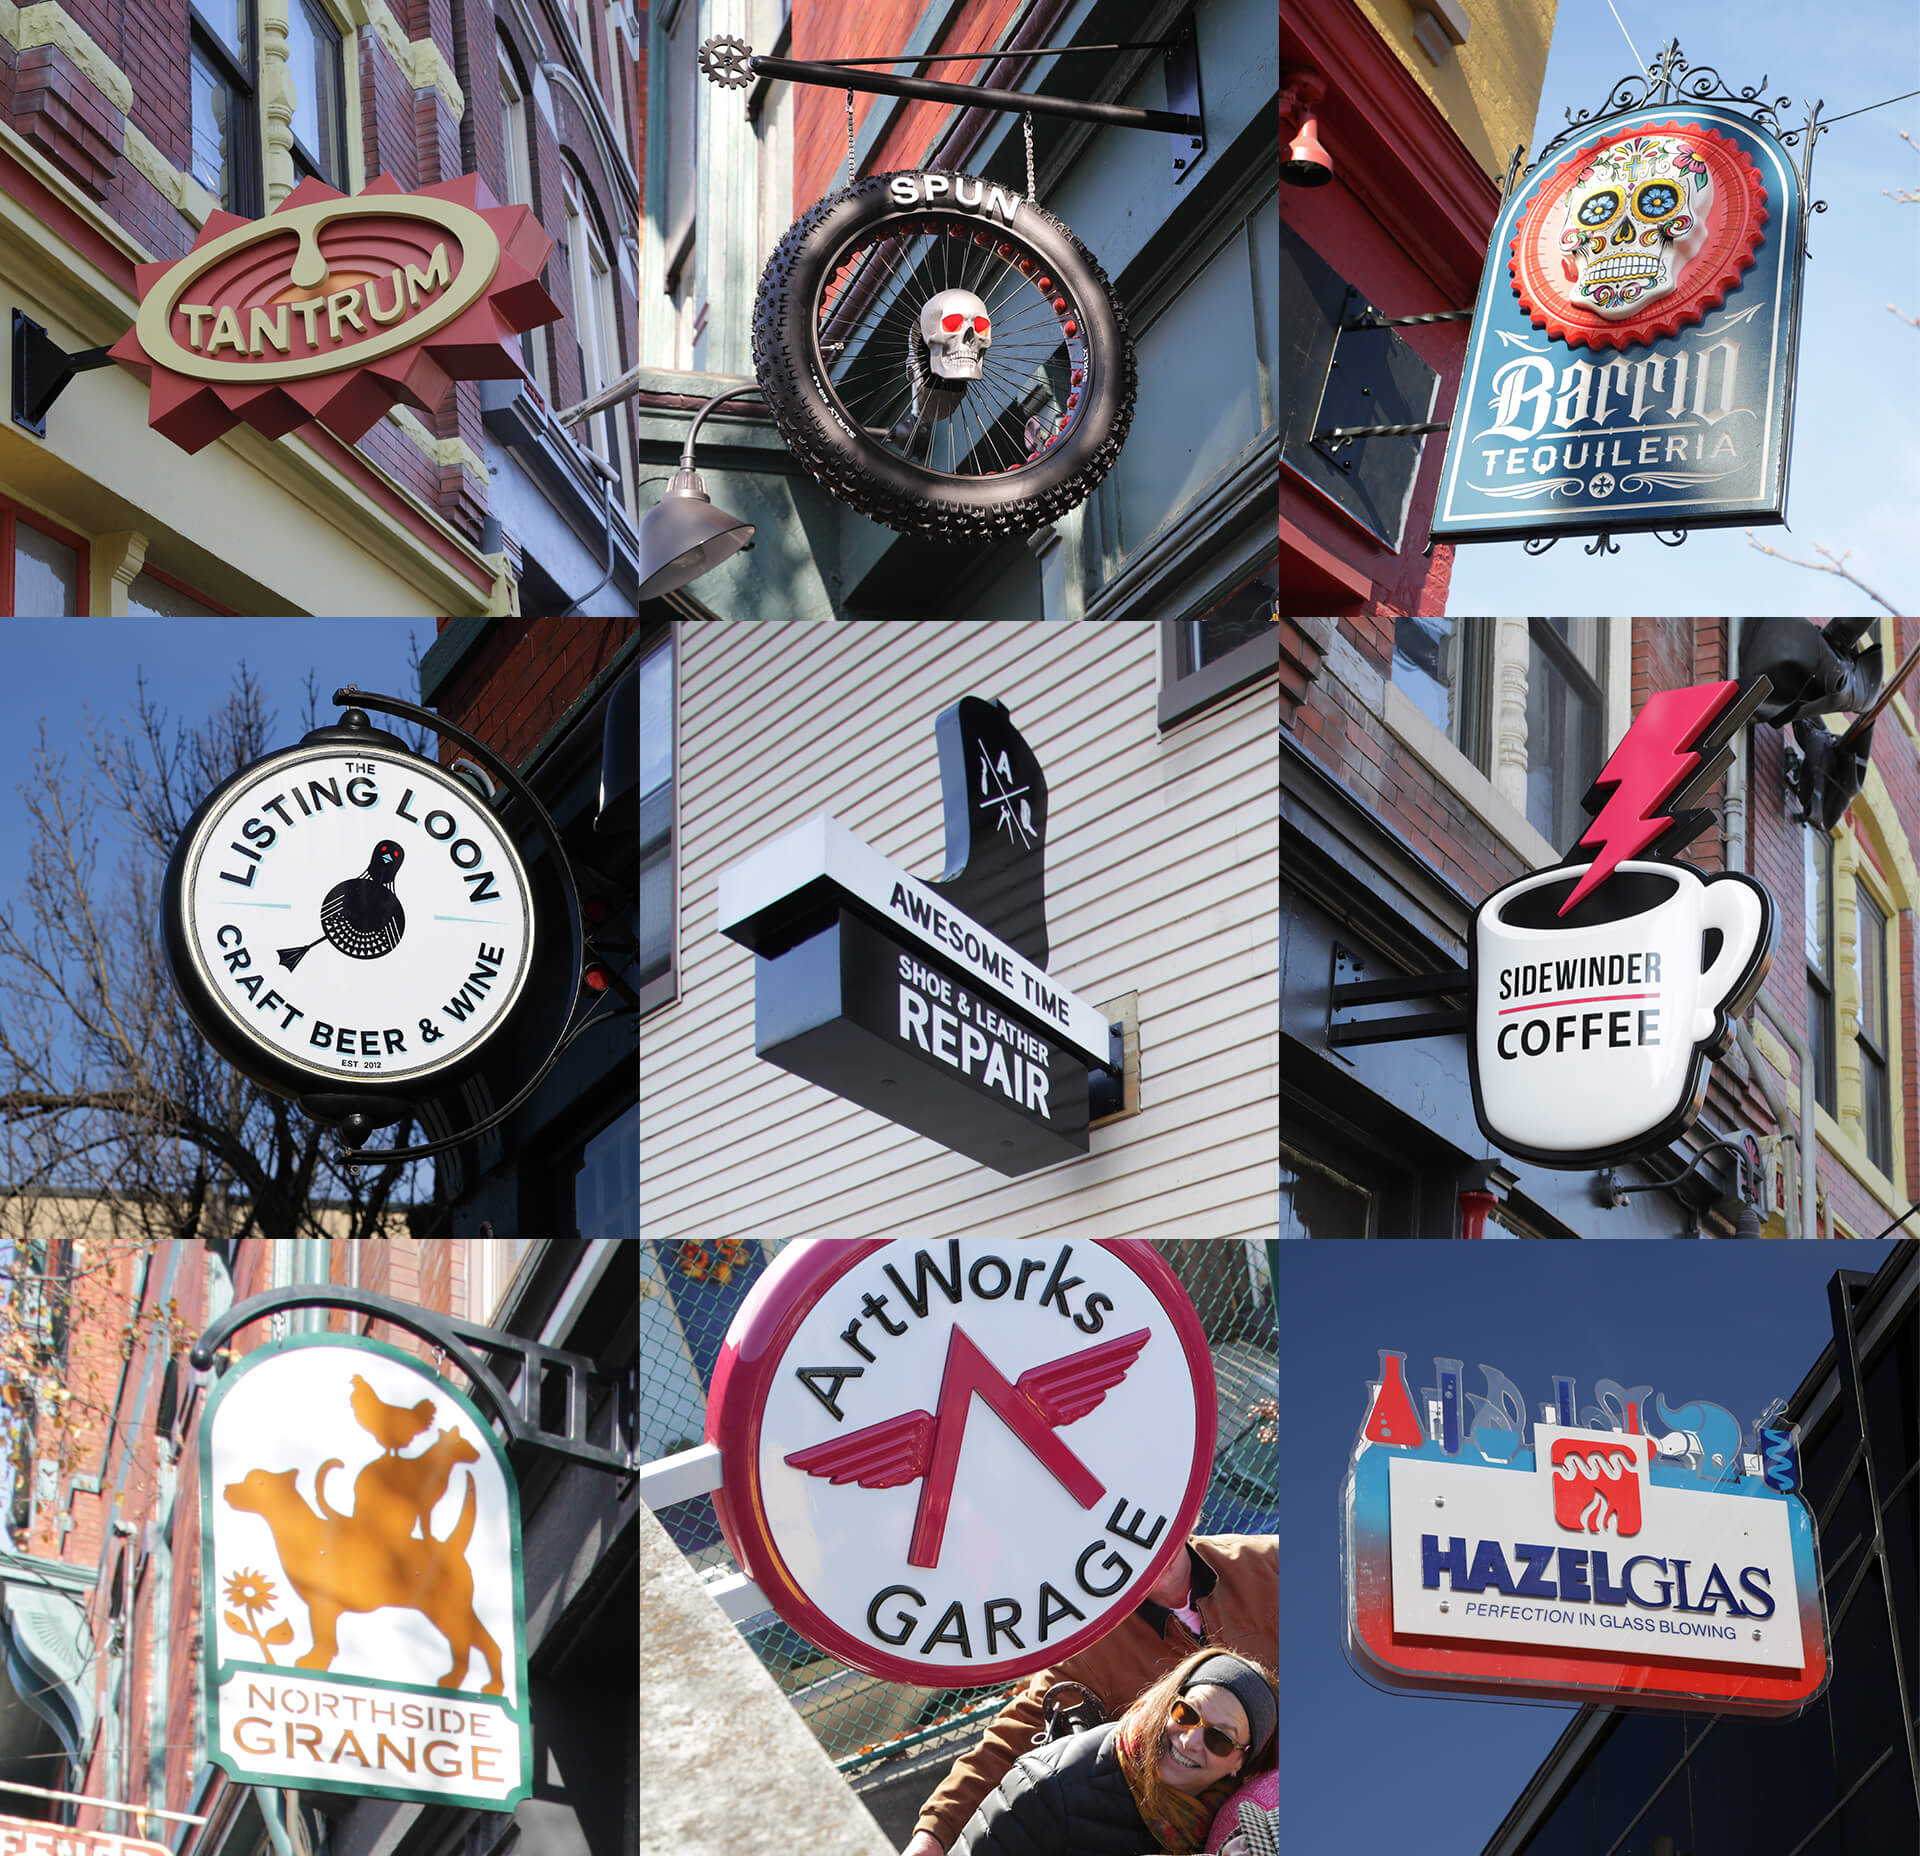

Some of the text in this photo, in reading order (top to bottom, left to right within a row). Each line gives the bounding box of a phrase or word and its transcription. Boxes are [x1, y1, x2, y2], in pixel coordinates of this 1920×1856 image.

[890, 174, 1021, 224] SPUN
[178, 243, 452, 356] TANTRUM
[1482, 433, 1738, 476] TEQUILERIA
[345, 762, 376, 775] THE
[219, 776, 501, 903] LISTING LOON
[889, 881, 1071, 1028] AWESOME TIME
[1499, 952, 1662, 1000] SIDEWINDER
[216, 924, 505, 1057] CRAFT BEER & WINE
[899, 955, 1050, 1067] SHOE & LEATHER
[341, 1059, 382, 1070] EST 2012
[899, 985, 1052, 1119] REPAIR
[1498, 1008, 1661, 1060] COFFEE
[795, 1239, 1115, 1422] ArtWorks
[866, 1497, 1168, 1658] GARAGE
[1465, 1602, 1738, 1641] PERFECTION IN GLASS BLOWING
[247, 1683, 494, 1738] NORTHSIDE
[233, 1716, 505, 1783] GRANGE
